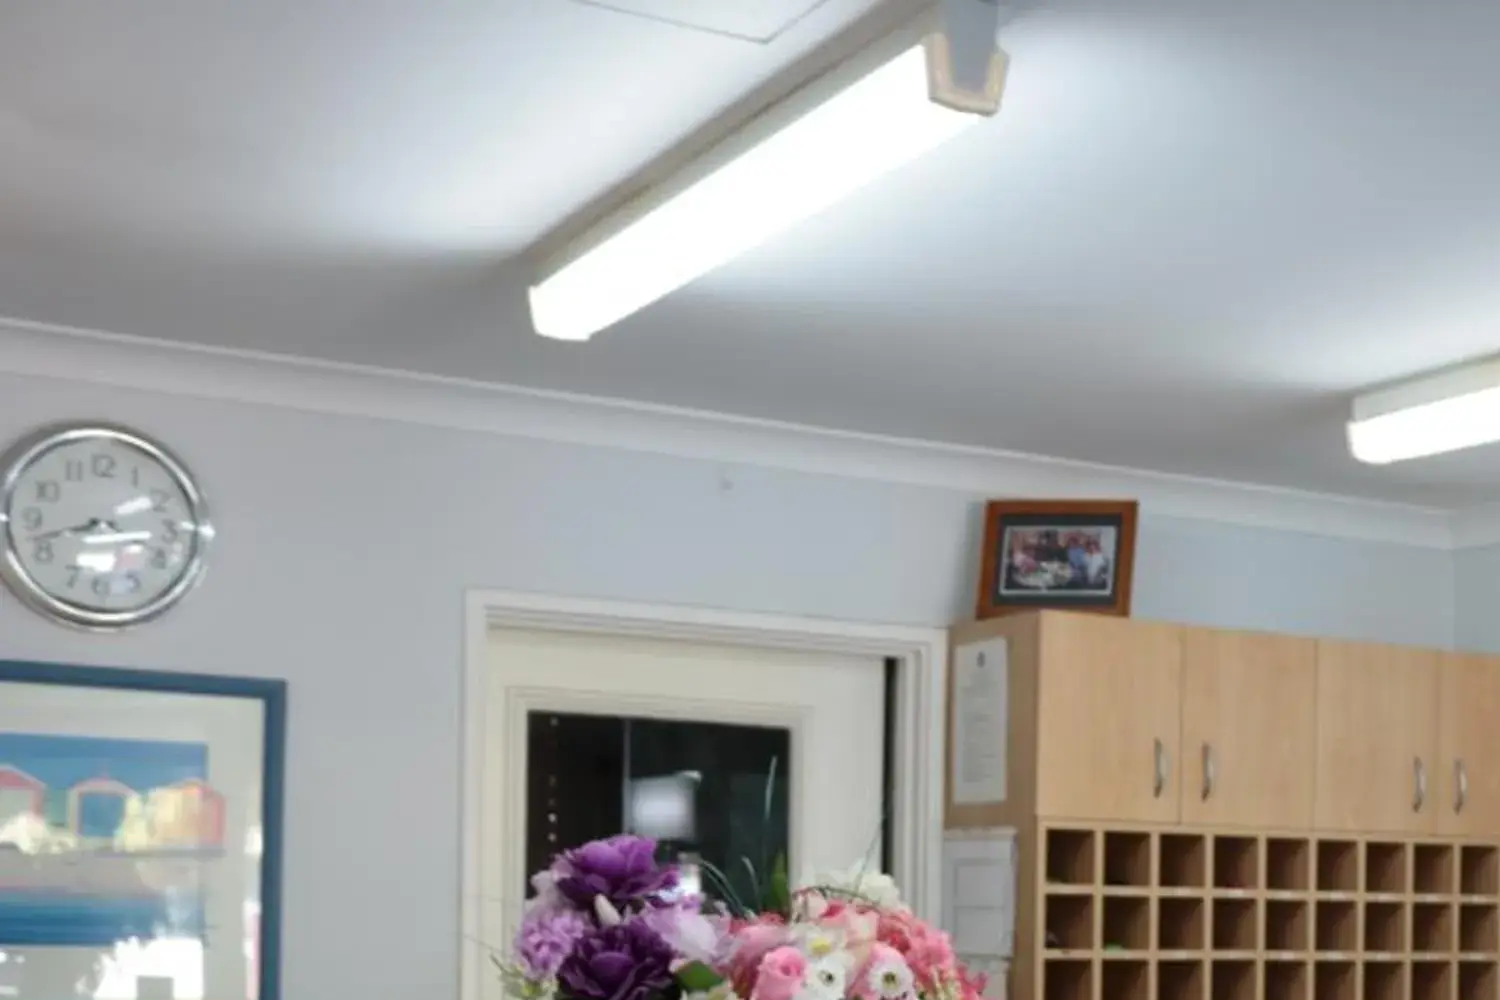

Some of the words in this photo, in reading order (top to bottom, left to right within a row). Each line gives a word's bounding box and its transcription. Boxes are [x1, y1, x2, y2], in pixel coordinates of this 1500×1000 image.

[65, 460, 84, 482] 11
[91, 454, 117, 479] 12
[130, 465, 139, 488] 1
[35, 480, 61, 503] 10
[151, 489, 170, 513] 2
[21, 507, 43, 531] 9
[161, 519, 178, 544] 3
[34, 540, 54, 563] 8
[151, 547, 167, 570] 4
[64, 564, 82, 589] 7
[91, 575, 109, 597] 6
[125, 570, 141, 594] 5
